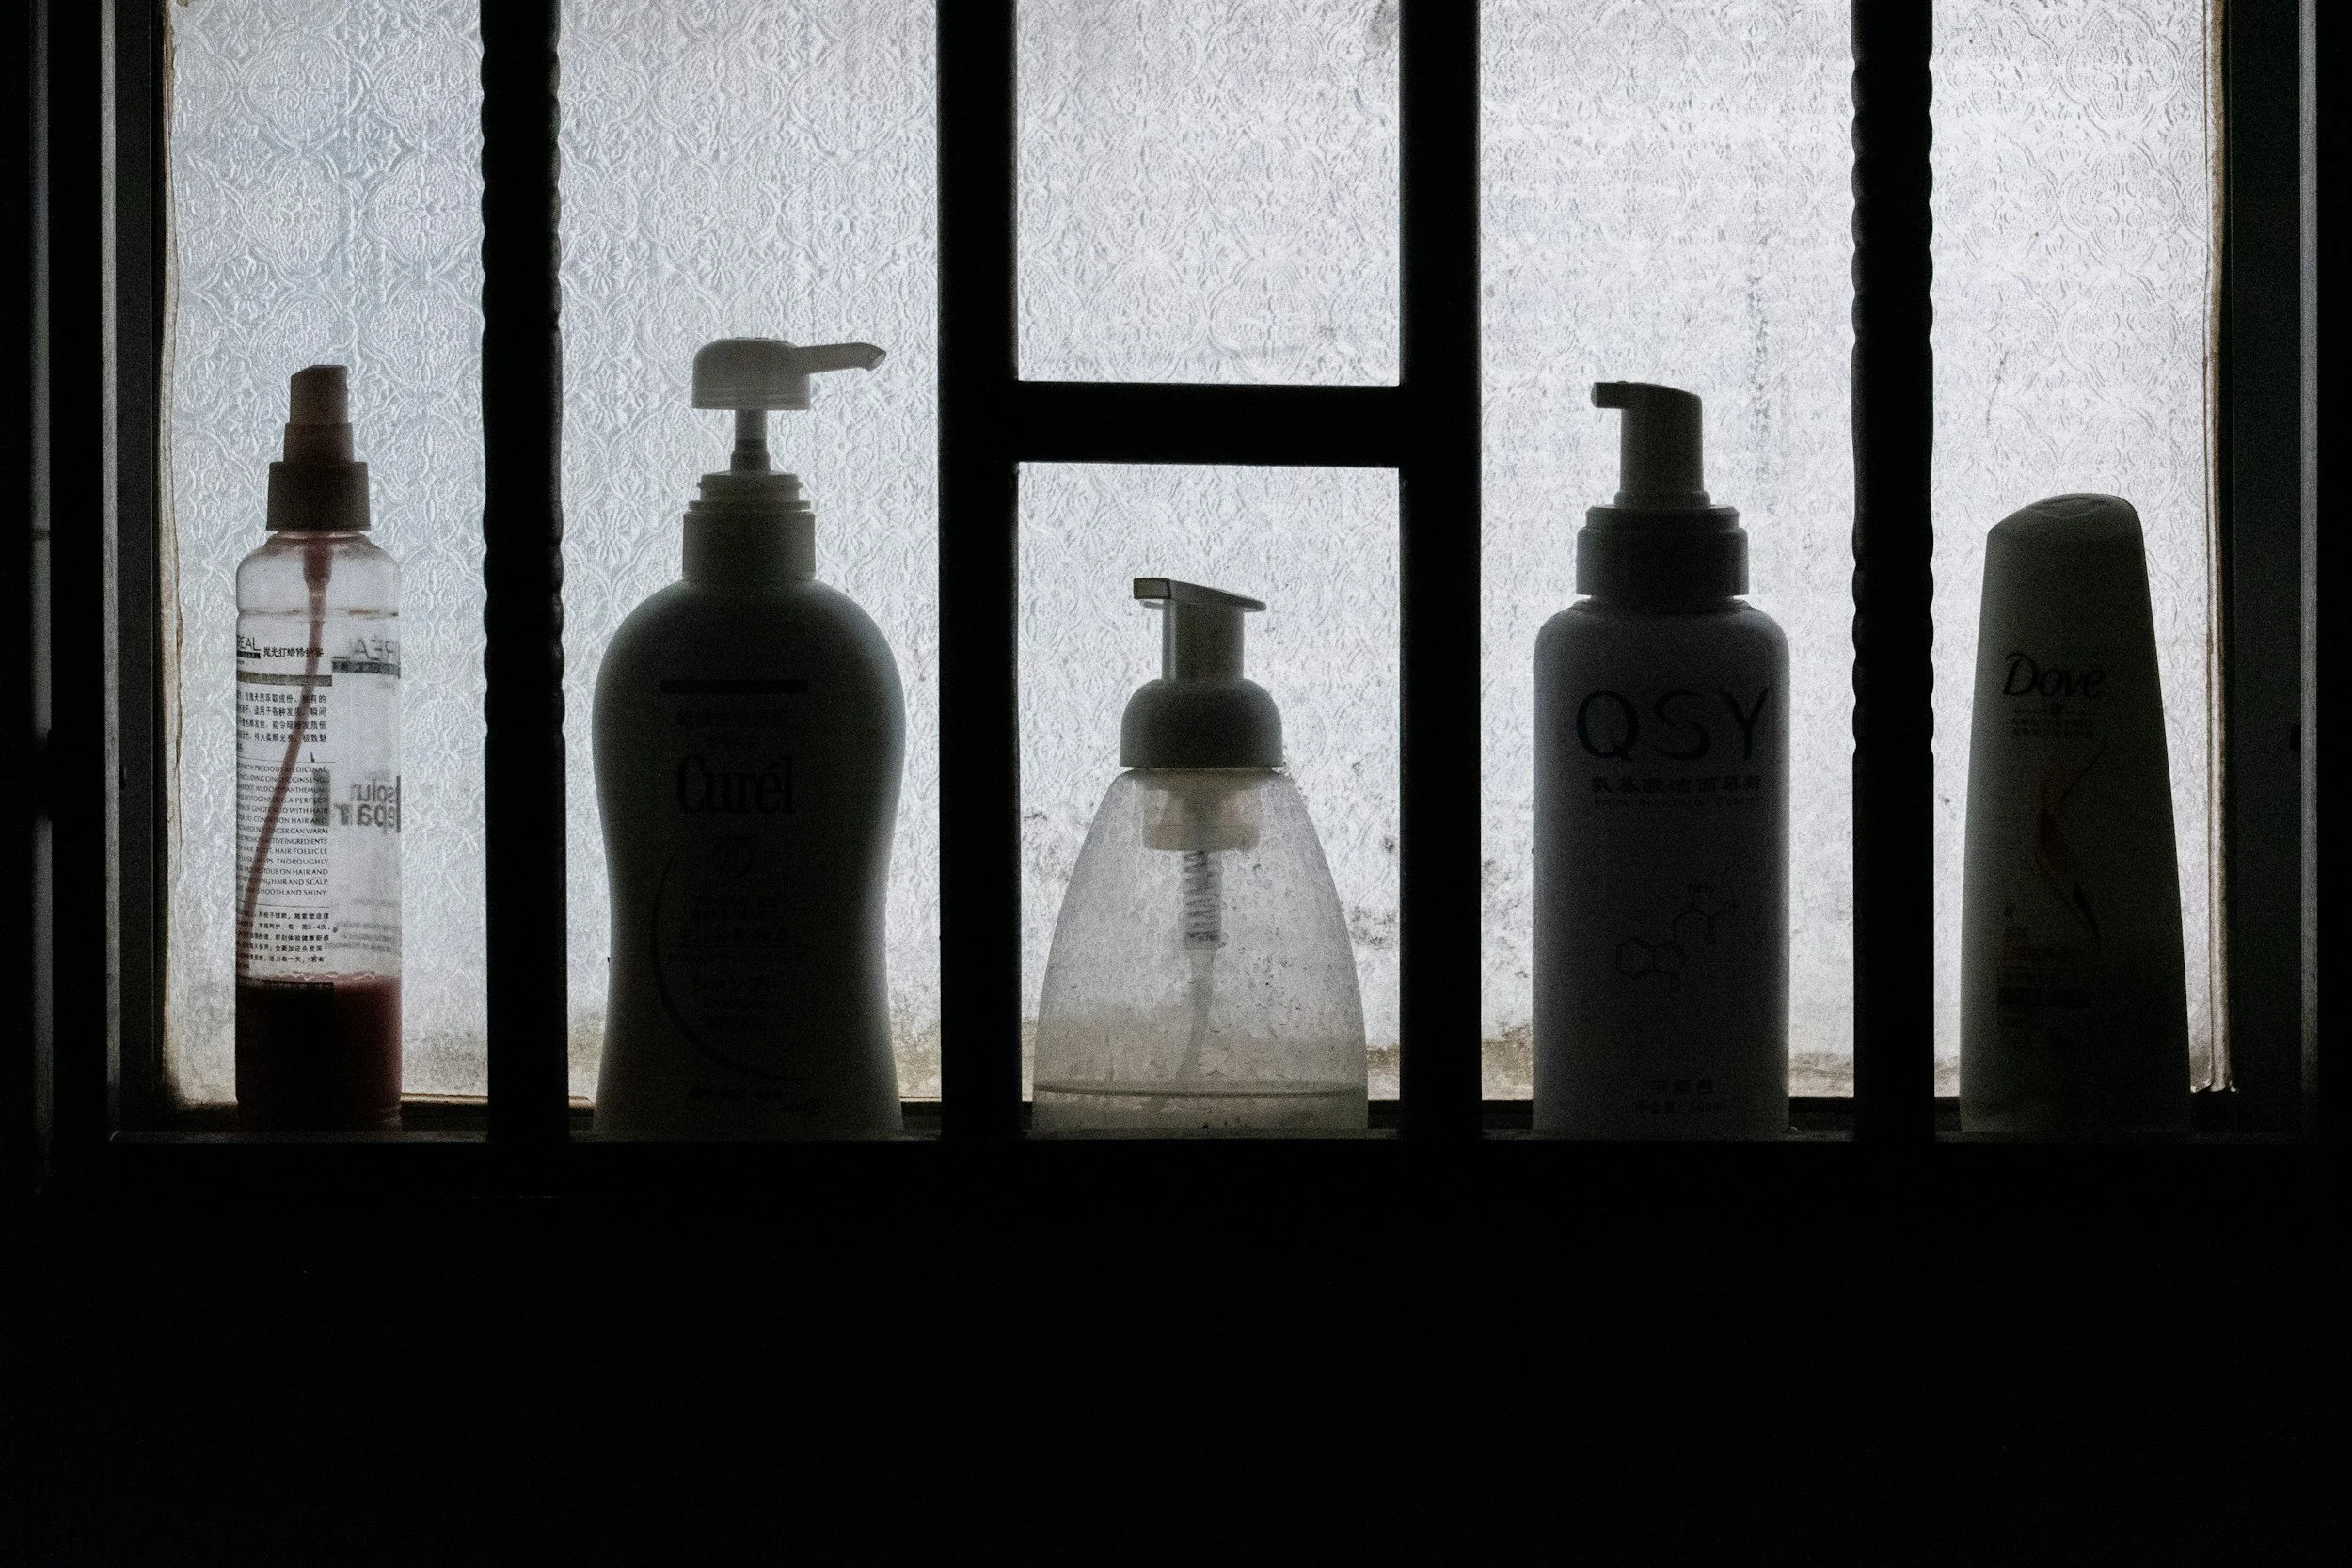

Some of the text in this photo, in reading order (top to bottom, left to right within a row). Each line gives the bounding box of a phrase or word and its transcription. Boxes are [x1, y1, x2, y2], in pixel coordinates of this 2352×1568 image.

[2003, 652, 2107, 699] Dove
[1577, 688, 1770, 762] QSY
[677, 754, 795, 815] Curél
